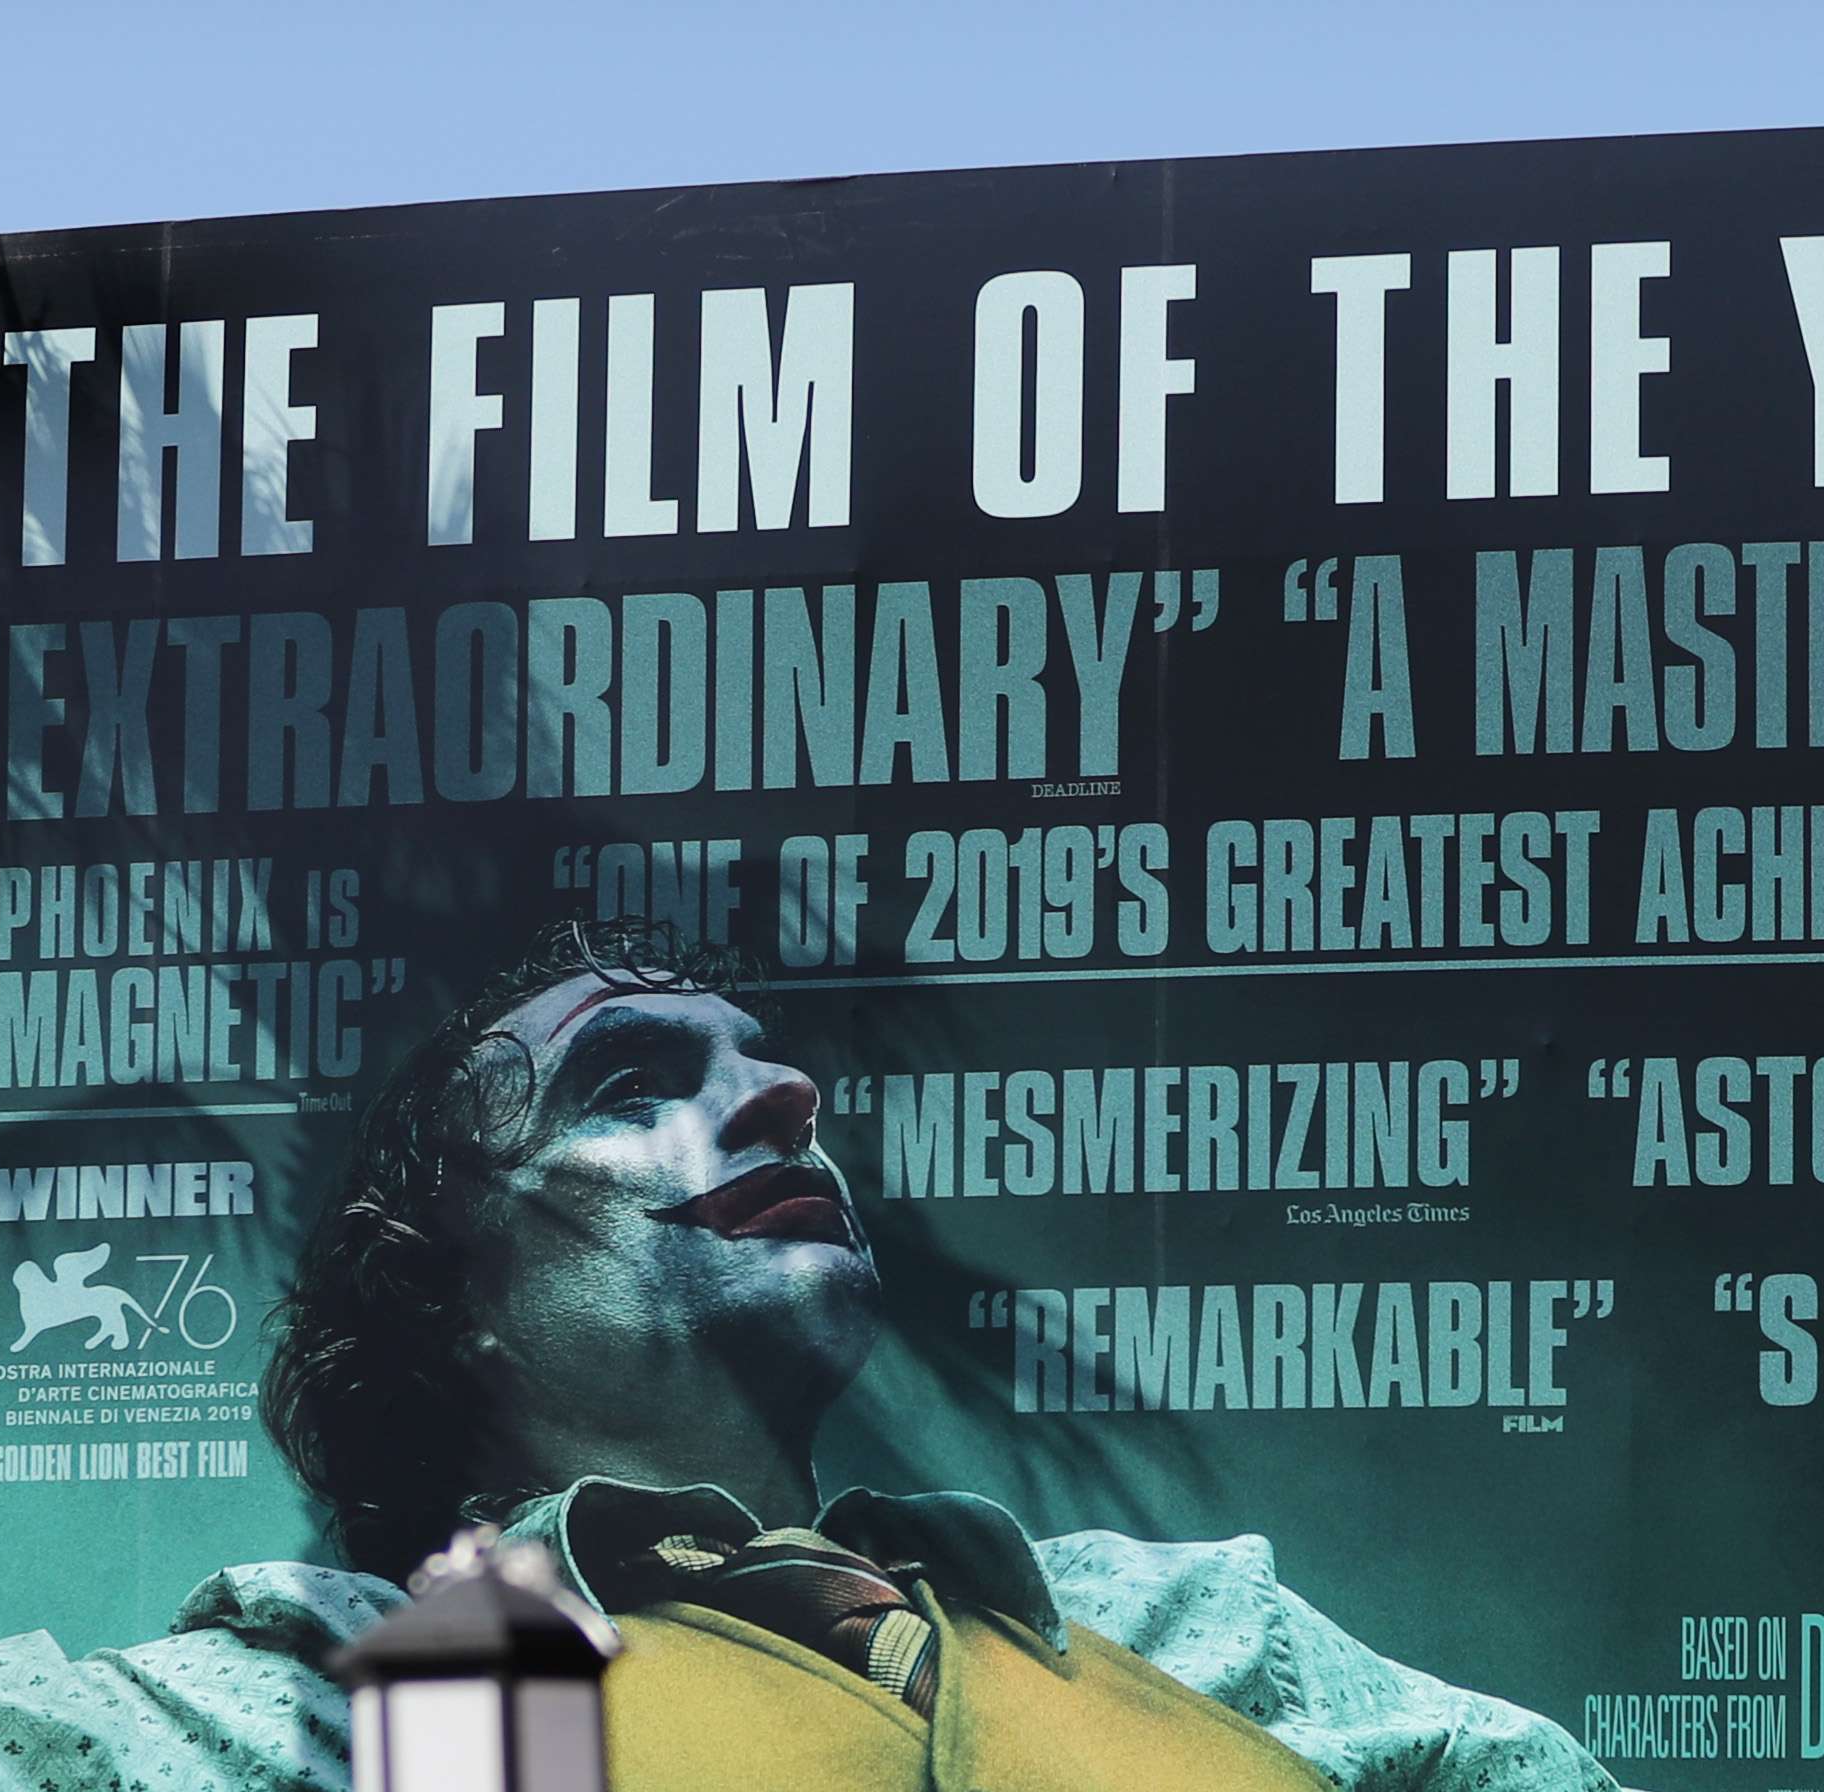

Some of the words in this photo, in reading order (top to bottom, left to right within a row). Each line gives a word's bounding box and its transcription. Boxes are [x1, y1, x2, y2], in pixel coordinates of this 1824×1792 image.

[428, 282, 854, 545] FILM
[972, 265, 1196, 518] OF
[1311, 241, 1671, 504] THE
[1284, 554, 1416, 760] “A
[1031, 781, 1121, 798] DEADLINE
[306, 868, 361, 950] IS
[779, 832, 868, 967] OF
[905, 823, 1169, 964] 2019’S
[1206, 811, 1600, 957] GREATEST
[299, 1094, 328, 1113] Time
[329, 1092, 352, 1112] Out
[833, 1058, 1519, 1199] “MESMERIZING”
[1286, 1203, 1322, 1225] Los
[1323, 1203, 1403, 1229] Angeles
[1407, 1203, 1471, 1224] Times
[136, 1254, 237, 1350] 76
[59, 1360, 216, 1379] INTERNAZIONALE
[968, 1279, 1614, 1414] “REMARKABLE”
[6, 1409, 94, 1426] BIENNALE
[100, 1408, 118, 1424] DI
[124, 1407, 202, 1423] VENEZIA
[207, 1405, 253, 1421] 2019
[18, 1386, 82, 1402] D’ARTE
[88, 1382, 260, 1401] CINEMATOGRAFICA
[1503, 1415, 1565, 1434] FILM
[79, 1443, 129, 1480] LION
[136, 1441, 191, 1479] BEST
[198, 1440, 248, 1477] FILM
[1681, 1616, 1749, 1680] BASED
[1757, 1616, 1787, 1680] ON
[1584, 1694, 1718, 1760] CHARACTERS
[1727, 1694, 1787, 1759] FROM
